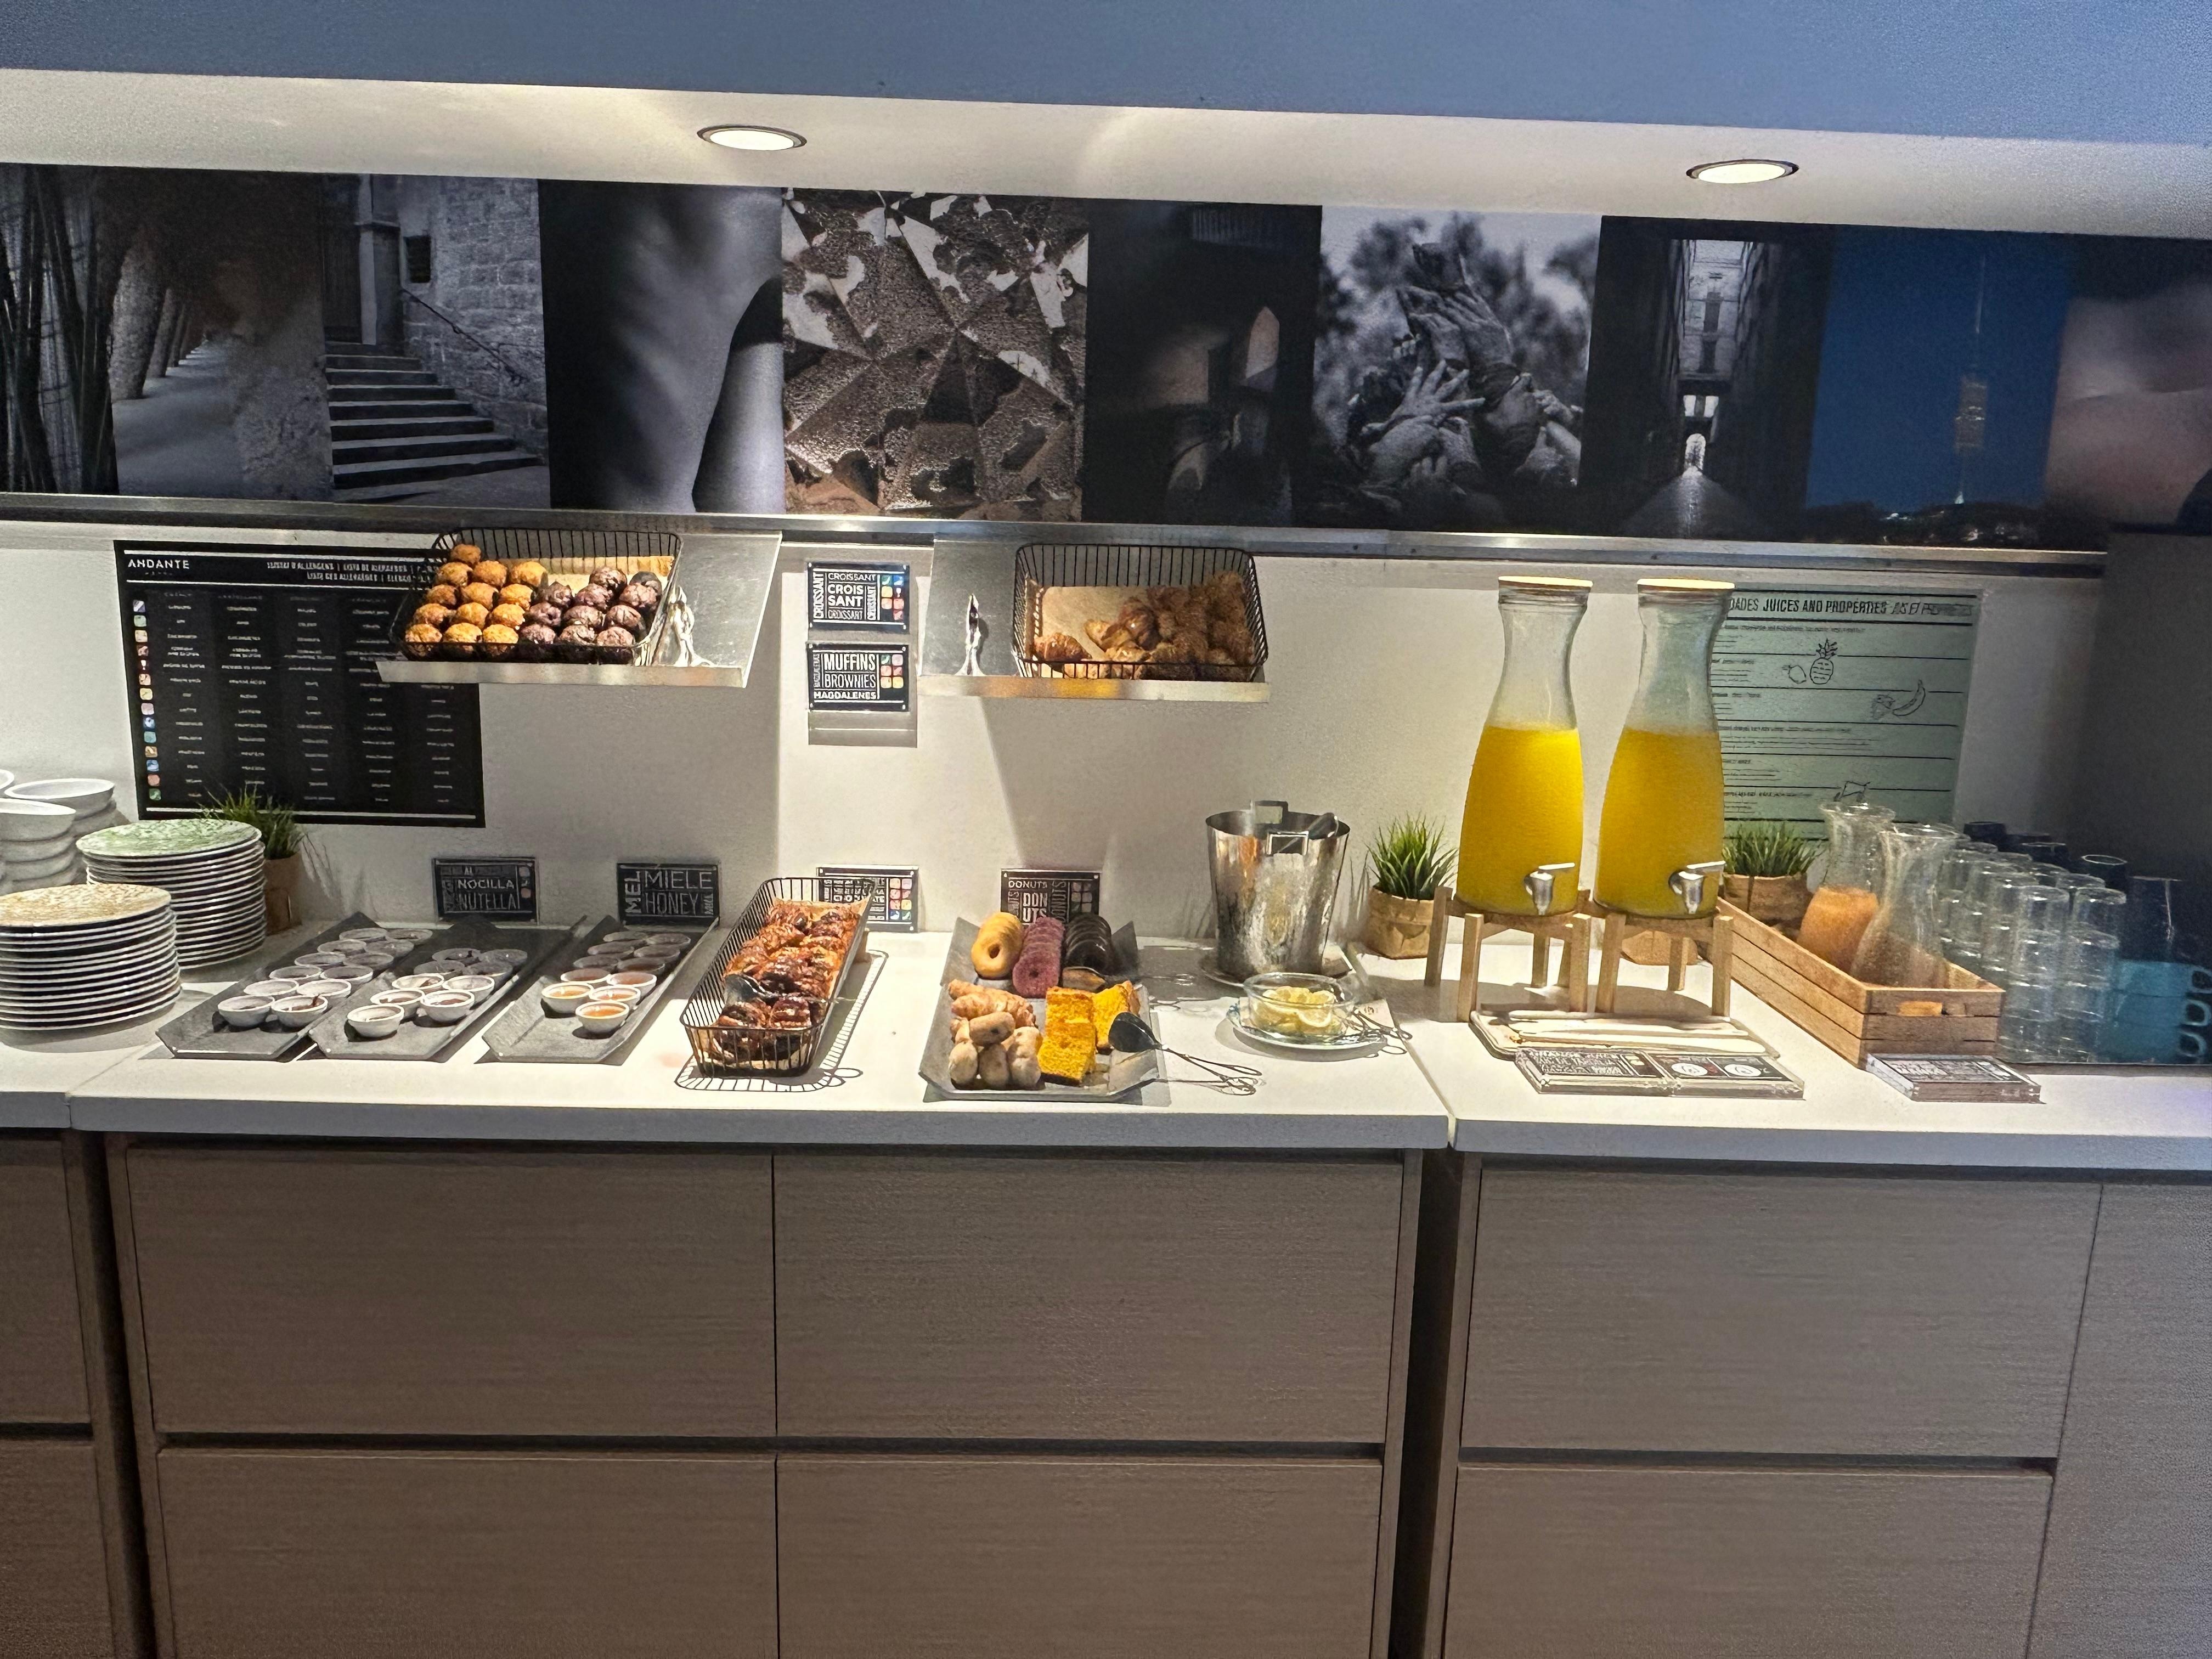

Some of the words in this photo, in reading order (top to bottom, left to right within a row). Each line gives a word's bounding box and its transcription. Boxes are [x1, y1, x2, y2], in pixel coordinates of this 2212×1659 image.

[128, 559, 190, 569] ANDANTE
[827, 584, 864, 595] CROIS
[827, 595, 864, 607] SANT
[1763, 599, 1800, 612] JUICES
[1802, 600, 1822, 613] AND
[1826, 600, 1887, 614] PROPERTIES
[823, 653, 876, 671] MUFFINS
[825, 674, 876, 689] BROWNIES
[458, 878, 515, 889] NOCILLA
[644, 870, 713, 889] MIELE
[1008, 881, 1047, 889] DONUTS
[624, 871, 642, 913] MEL
[1023, 892, 1048, 907] DON
[458, 892, 517, 911] NUTELLA
[645, 893, 698, 916] HONEY
